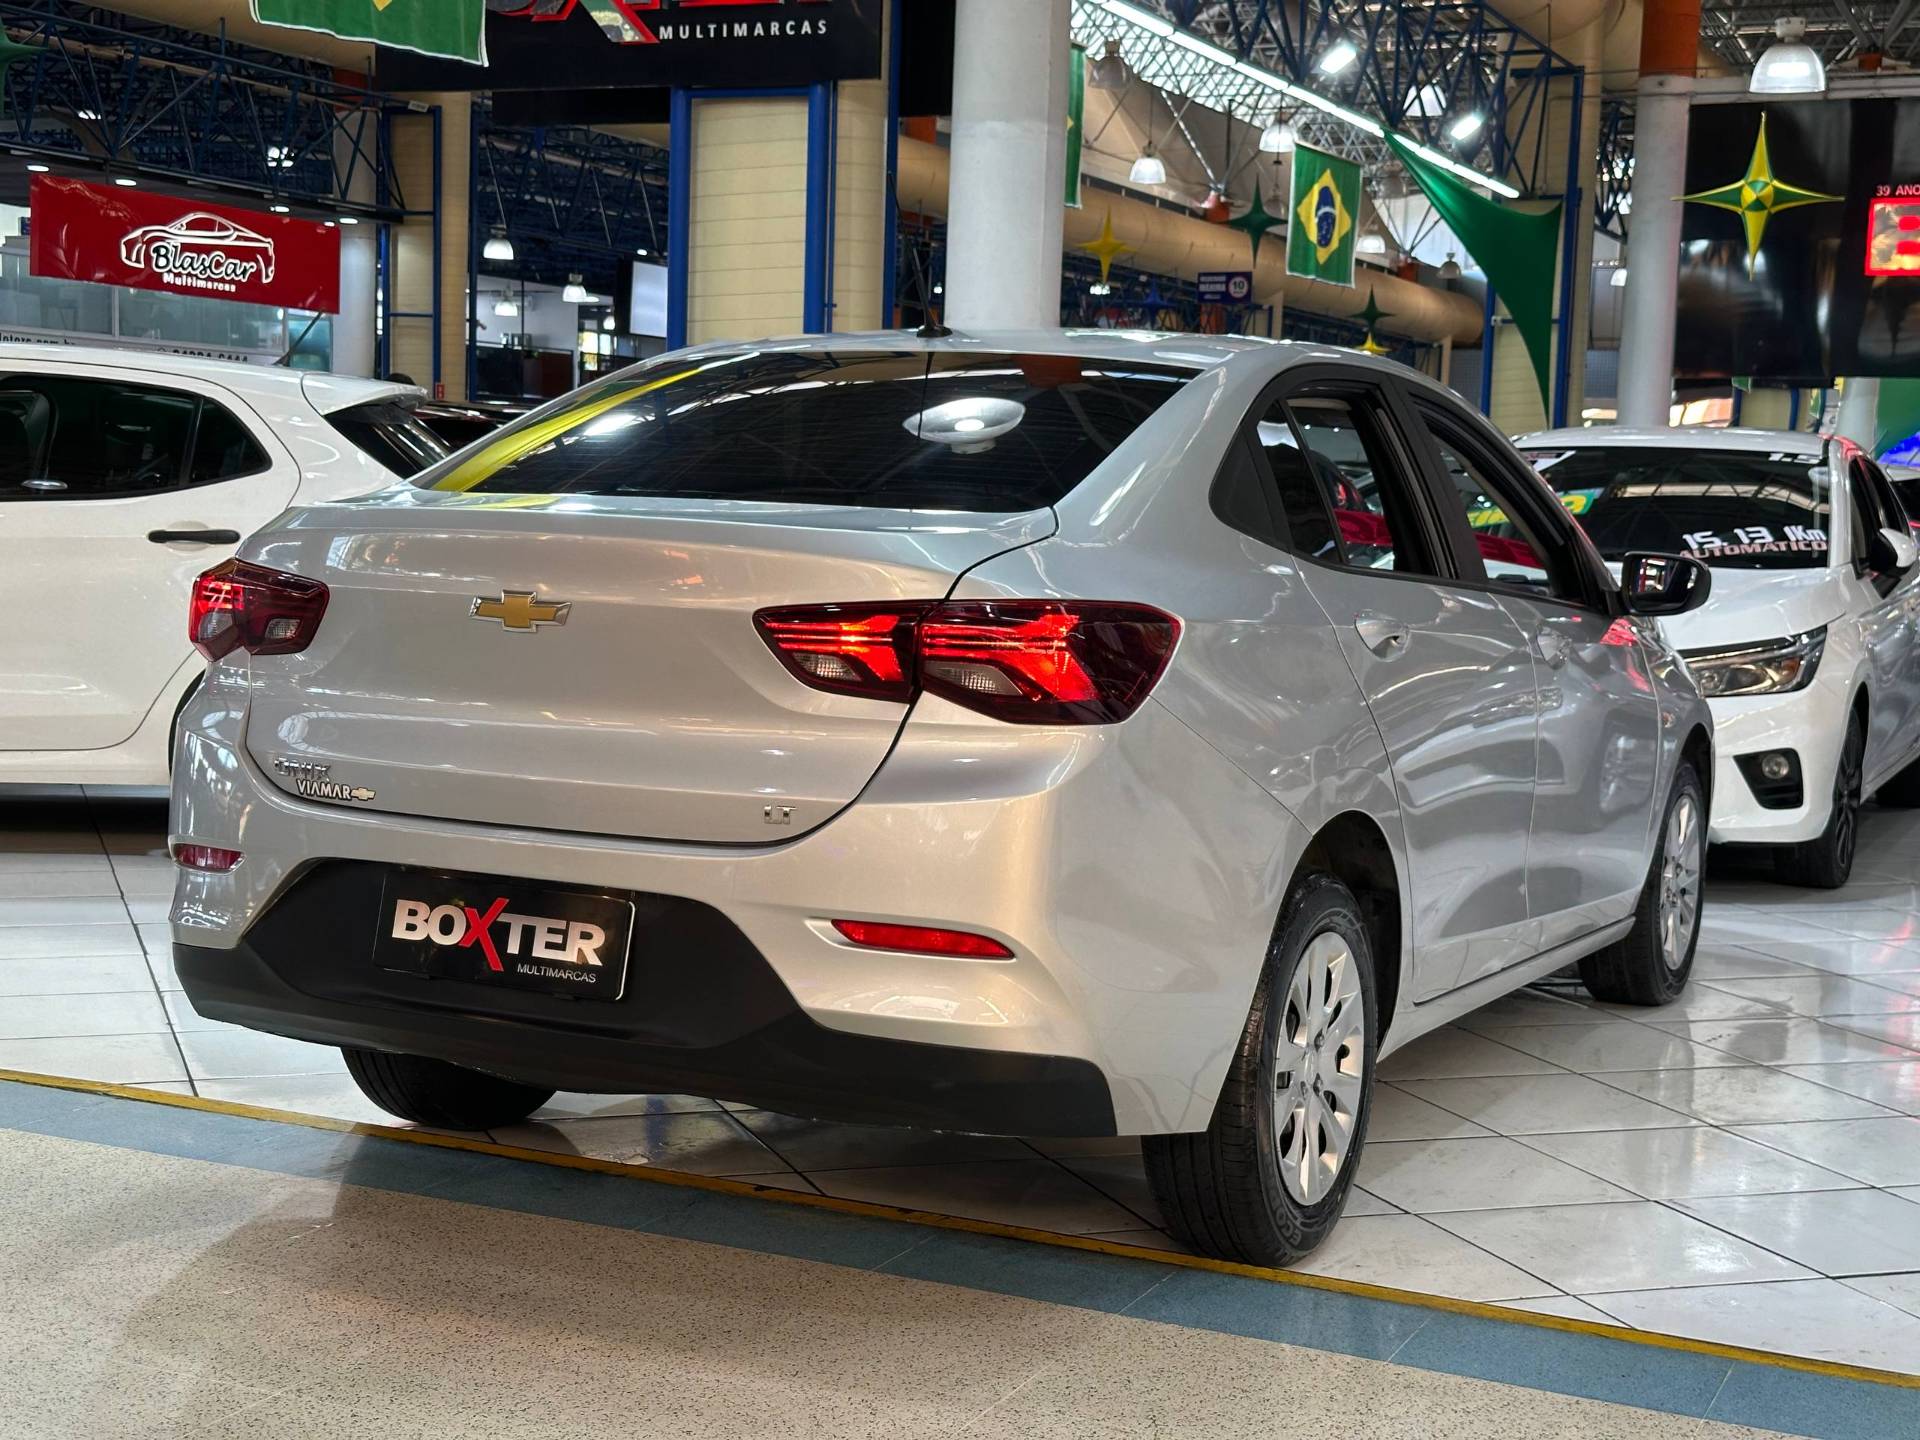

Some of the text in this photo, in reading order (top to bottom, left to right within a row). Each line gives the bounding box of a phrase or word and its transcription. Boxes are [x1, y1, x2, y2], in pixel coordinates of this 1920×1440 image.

[659, 20, 827, 40] MULTIMARCAS
[1876, 185, 1891, 197] 39
[151, 240, 256, 282] BlasCar
[296, 779, 352, 800] VIAMAR
[391, 897, 606, 972] BOXTER
[517, 963, 597, 983] MULTIMARCAS
